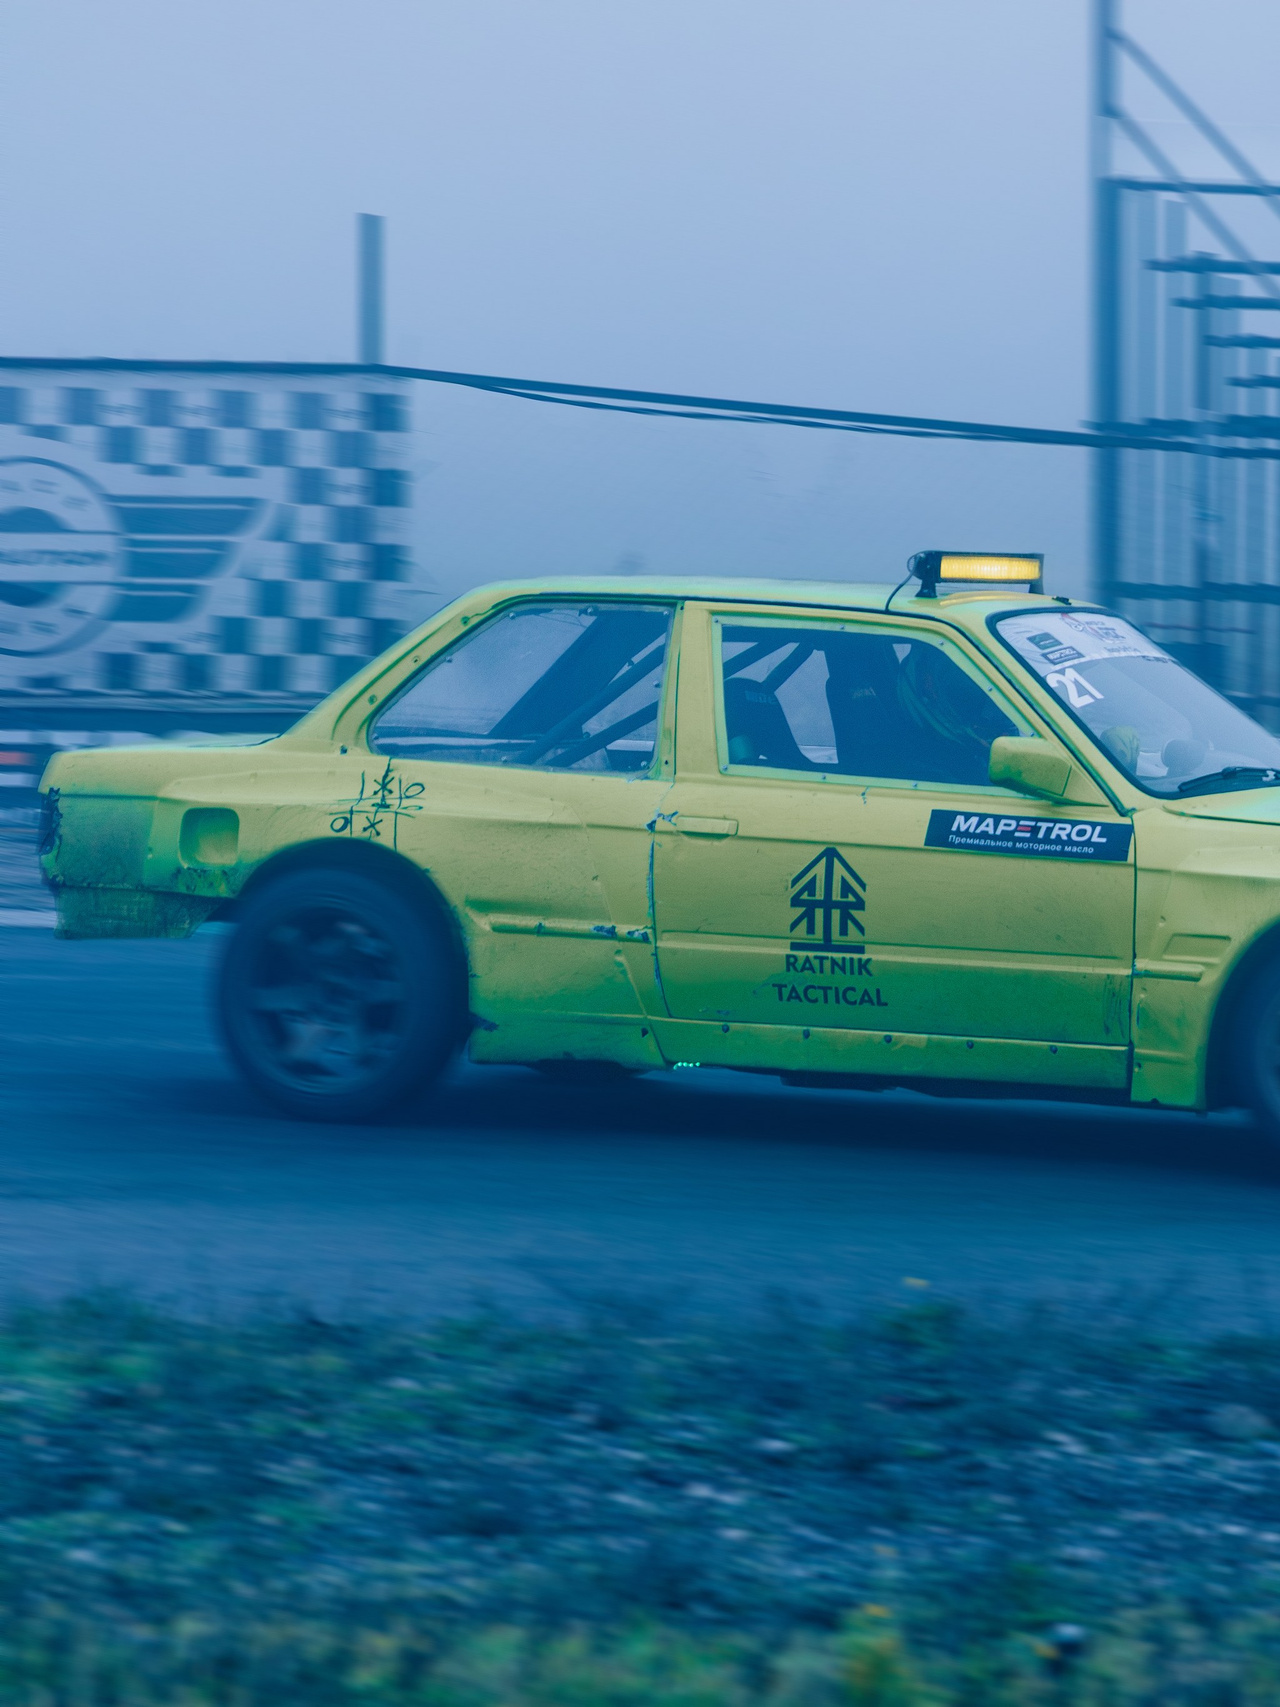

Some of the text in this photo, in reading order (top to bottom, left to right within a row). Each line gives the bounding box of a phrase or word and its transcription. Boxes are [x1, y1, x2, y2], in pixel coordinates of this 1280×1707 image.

[1045, 667, 1105, 709] 21
[950, 814, 1108, 843] MAPETROL
[948, 834, 1095, 855] Премиальное моторное масло
[784, 953, 874, 977] RATNIK
[771, 983, 889, 1007] TACTICAL
